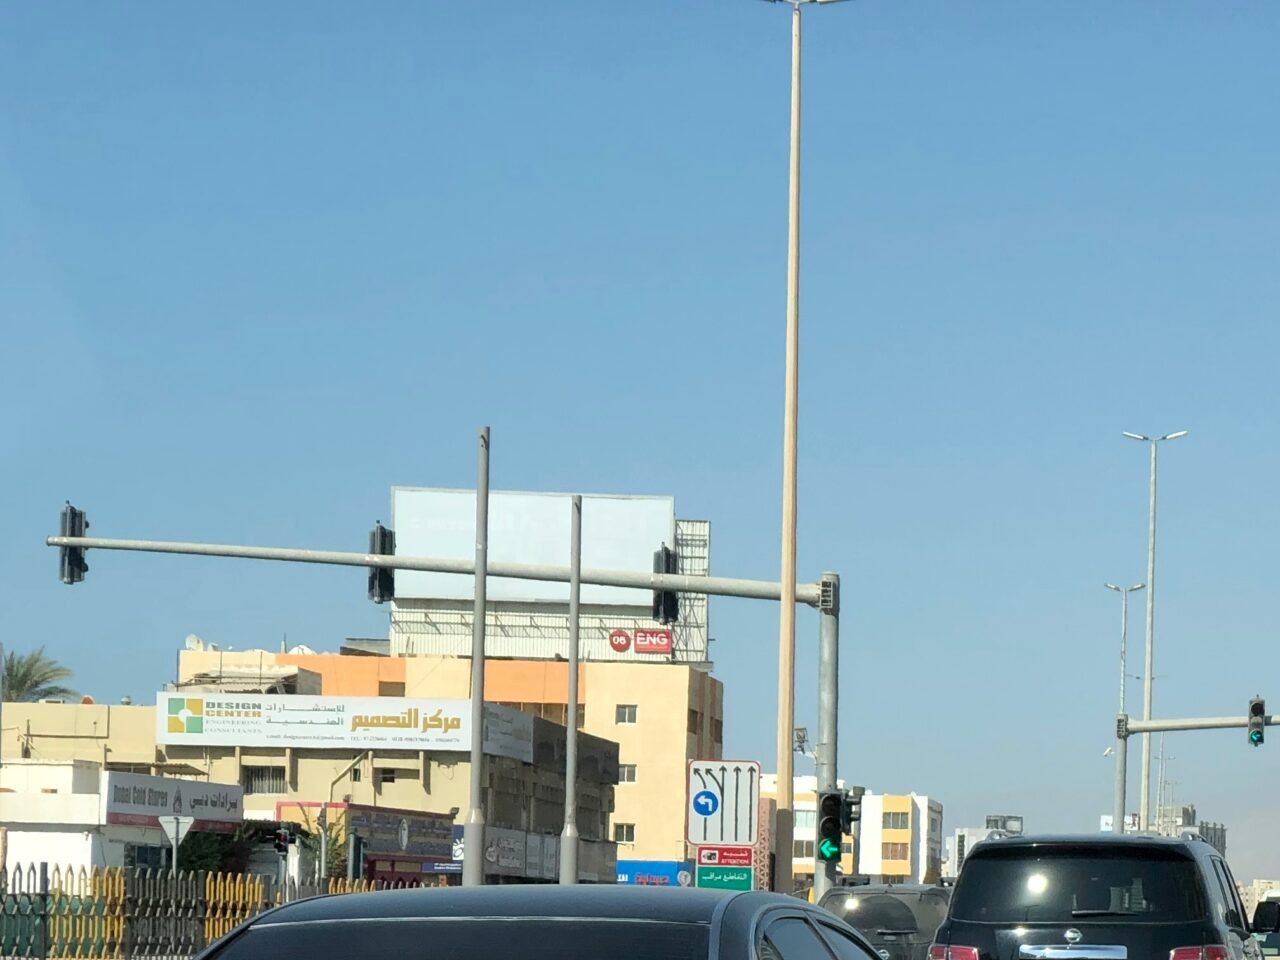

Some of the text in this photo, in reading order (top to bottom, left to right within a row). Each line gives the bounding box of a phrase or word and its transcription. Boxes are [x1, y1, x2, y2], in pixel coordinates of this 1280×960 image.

[636, 632, 669, 645] ENG
[205, 701, 262, 709] DESIGN
[205, 710, 262, 718] CENTER
[350, 708, 419, 732] التصميم
[265, 716, 344, 727] الهندسية
[421, 708, 461, 733] مركز
